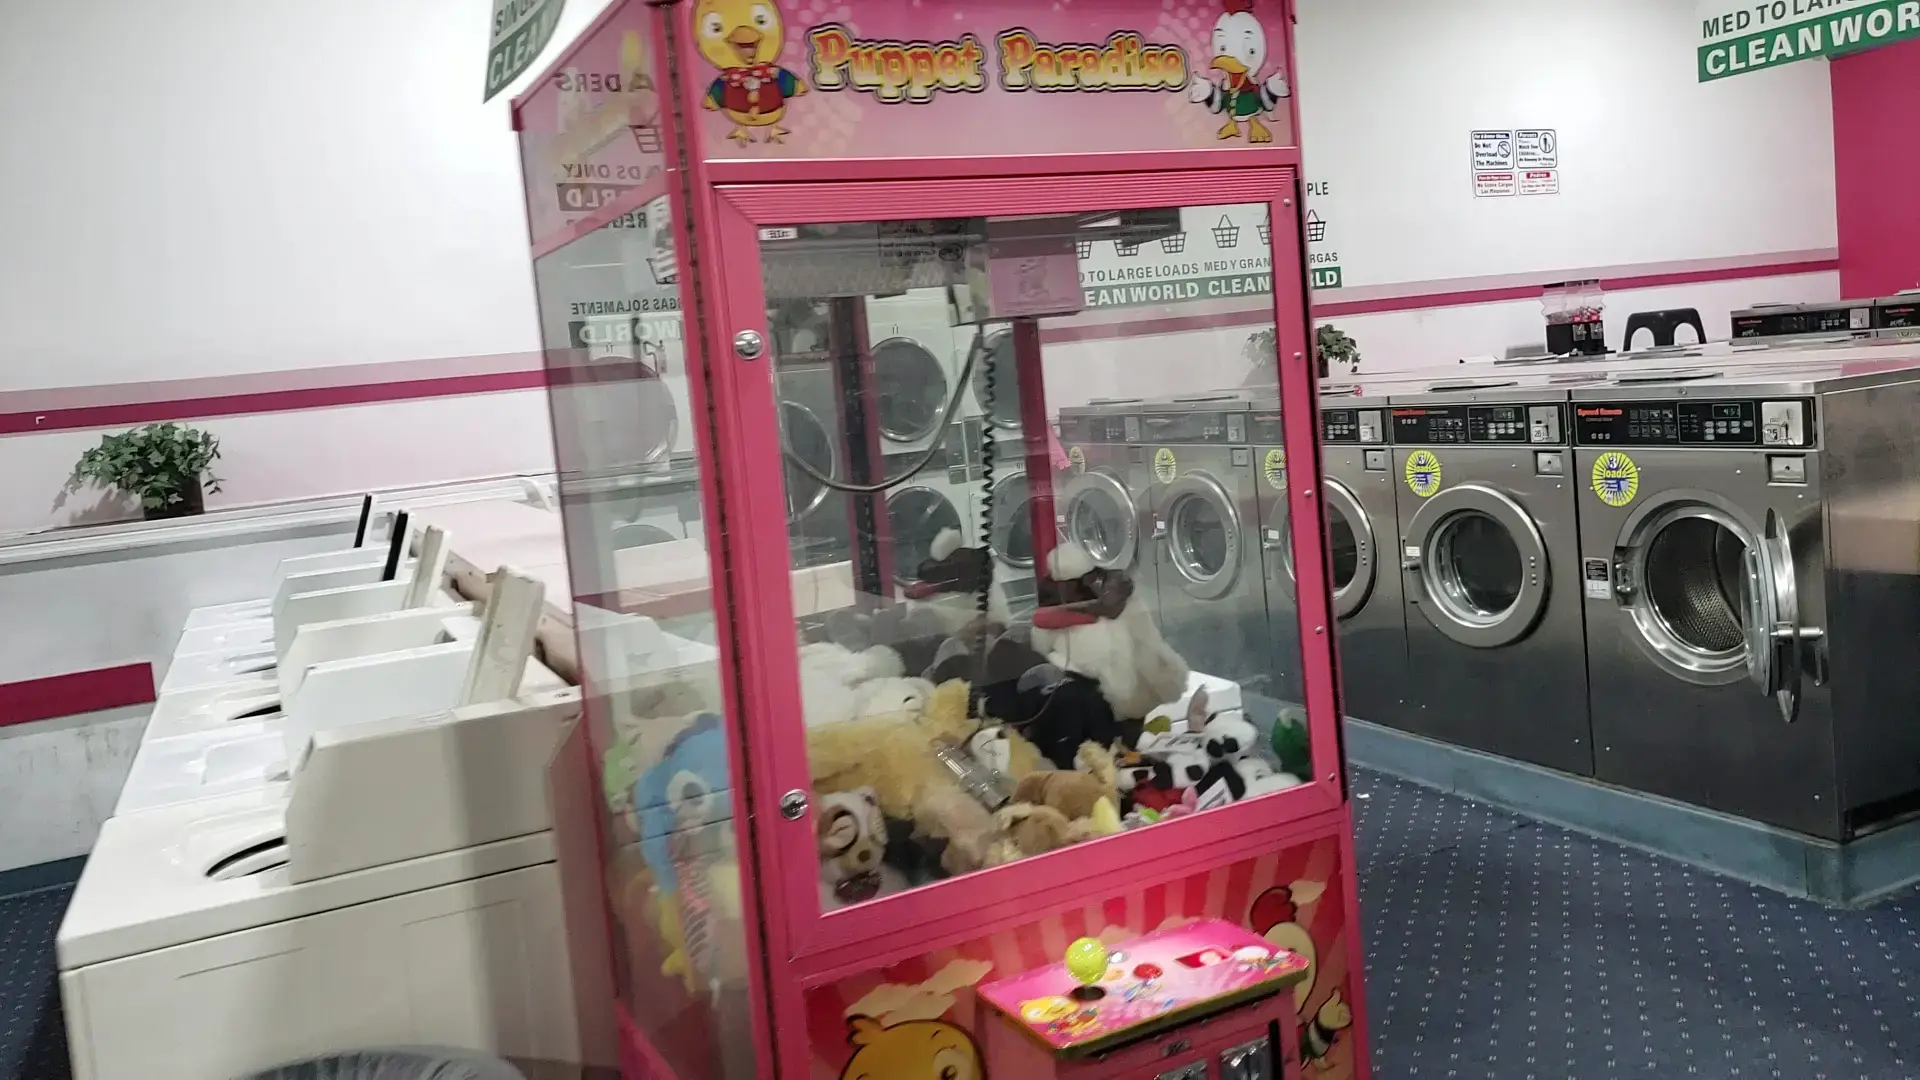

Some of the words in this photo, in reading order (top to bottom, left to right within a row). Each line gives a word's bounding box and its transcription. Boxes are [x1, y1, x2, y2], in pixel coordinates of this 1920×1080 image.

[1703, 10, 1750, 39] MED
[1755, 0, 1787, 24] TO
[1793, 0, 1855, 15] LA
[1705, 25, 1822, 76] CLEAN
[1829, 1, 1920, 47] WOR
[808, 25, 986, 102] Puppet
[997, 29, 1188, 90] Paradise
[1307, 182, 1329, 196] PLE
[1088, 270, 1106, 282] TO
[1109, 266, 1153, 280] LARGE
[1155, 263, 1199, 277] LOADS
[1204, 260, 1228, 272] MED
[1230, 259, 1237, 270] Y
[1130, 281, 1200, 303] WORLD
[1208, 276, 1270, 296] CLEAN
[1609, 456, 1618, 469] 3
